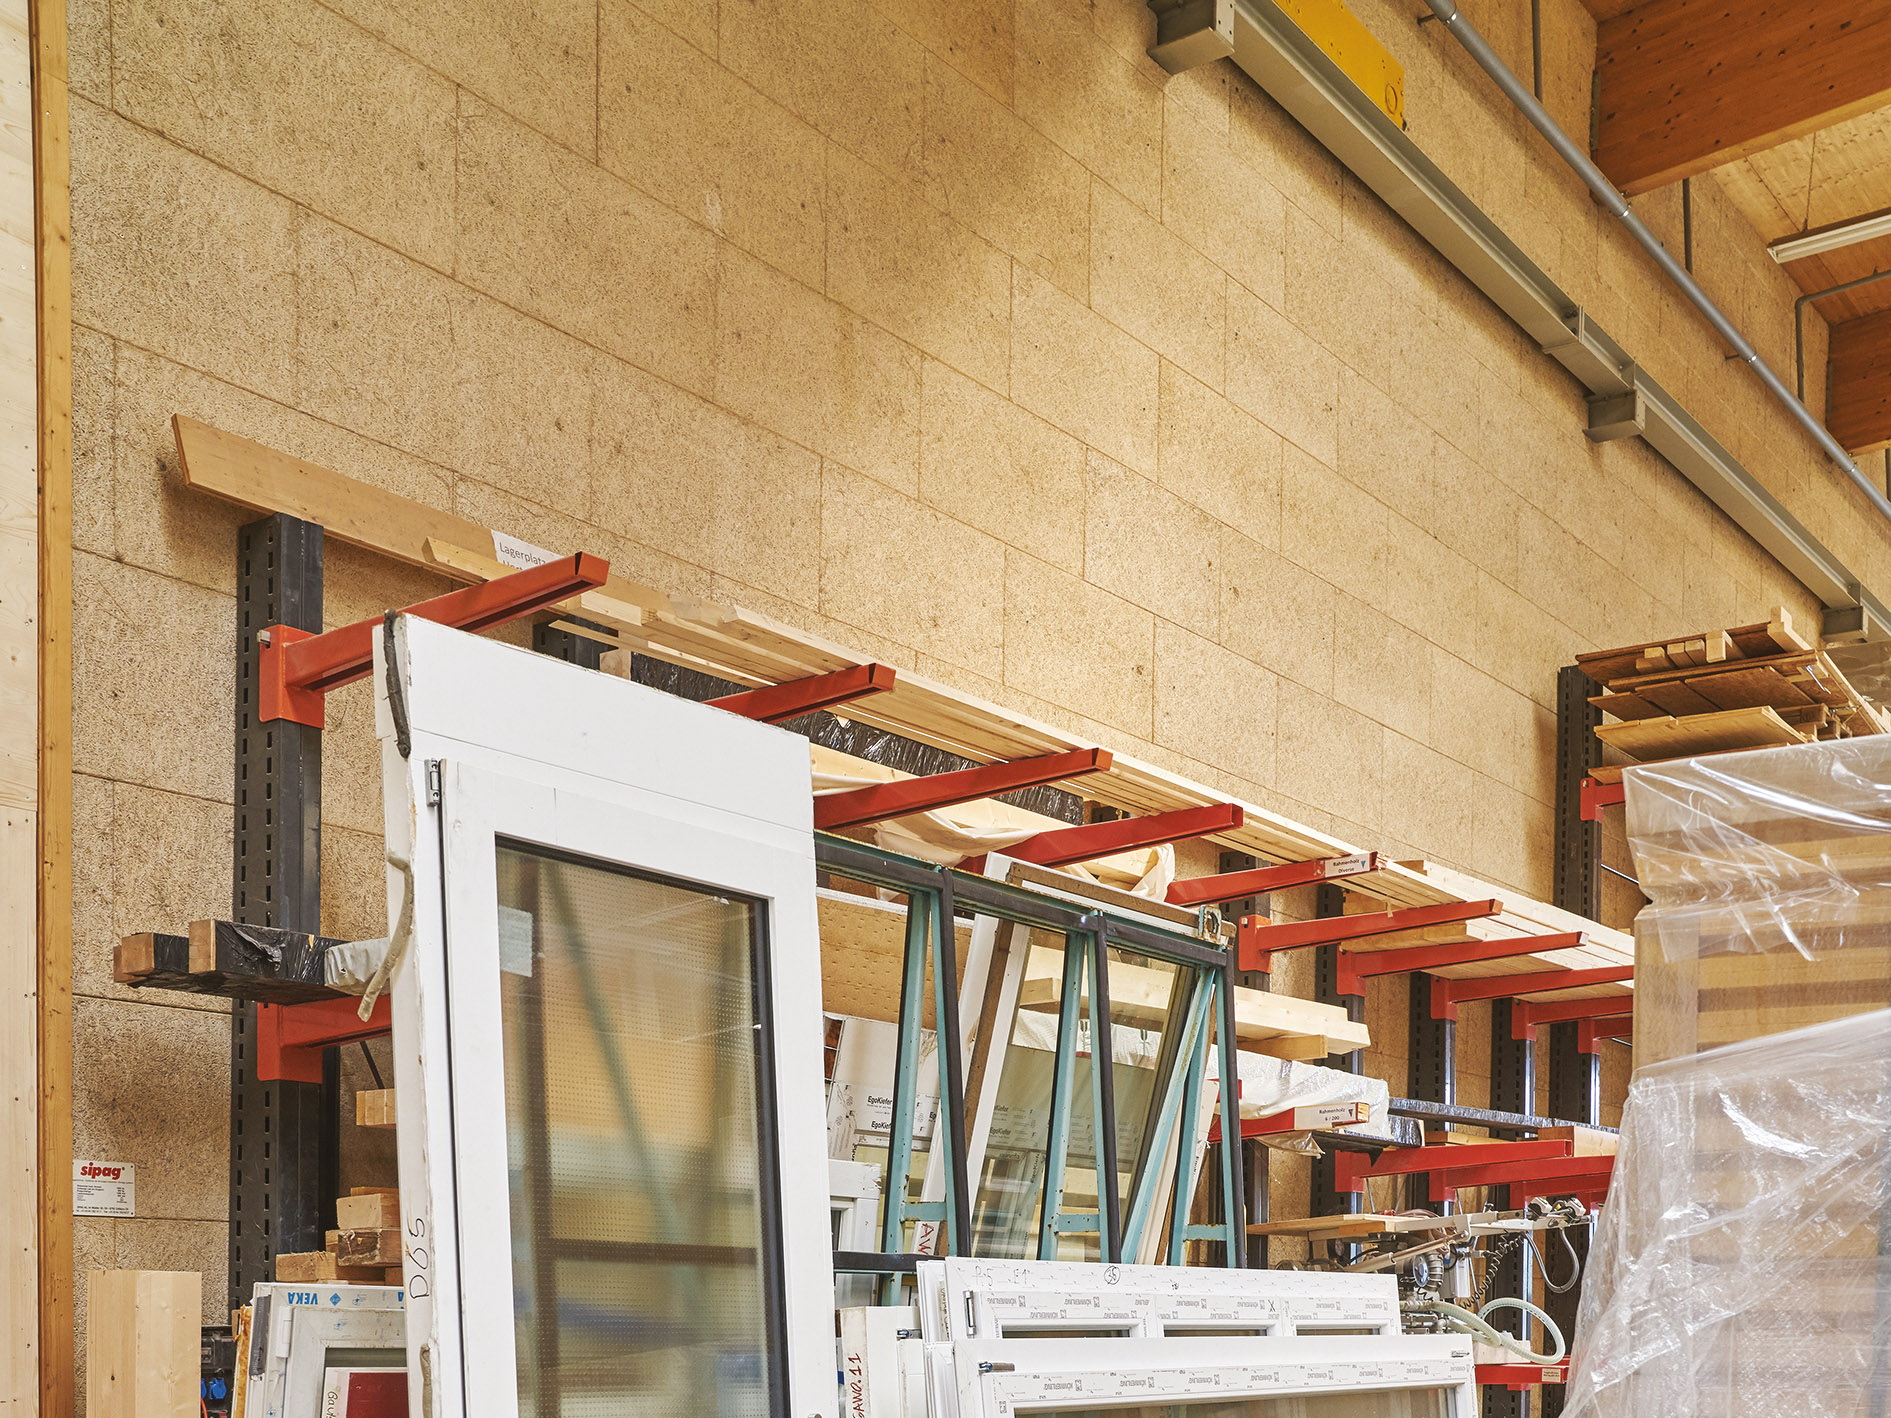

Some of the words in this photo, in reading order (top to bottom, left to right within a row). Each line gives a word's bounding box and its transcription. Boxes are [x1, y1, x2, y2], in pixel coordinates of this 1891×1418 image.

[867, 1095, 893, 1105] EgoKiefer
[81, 1162, 120, 1179] sipag
[288, 1292, 318, 1305] VEKA
